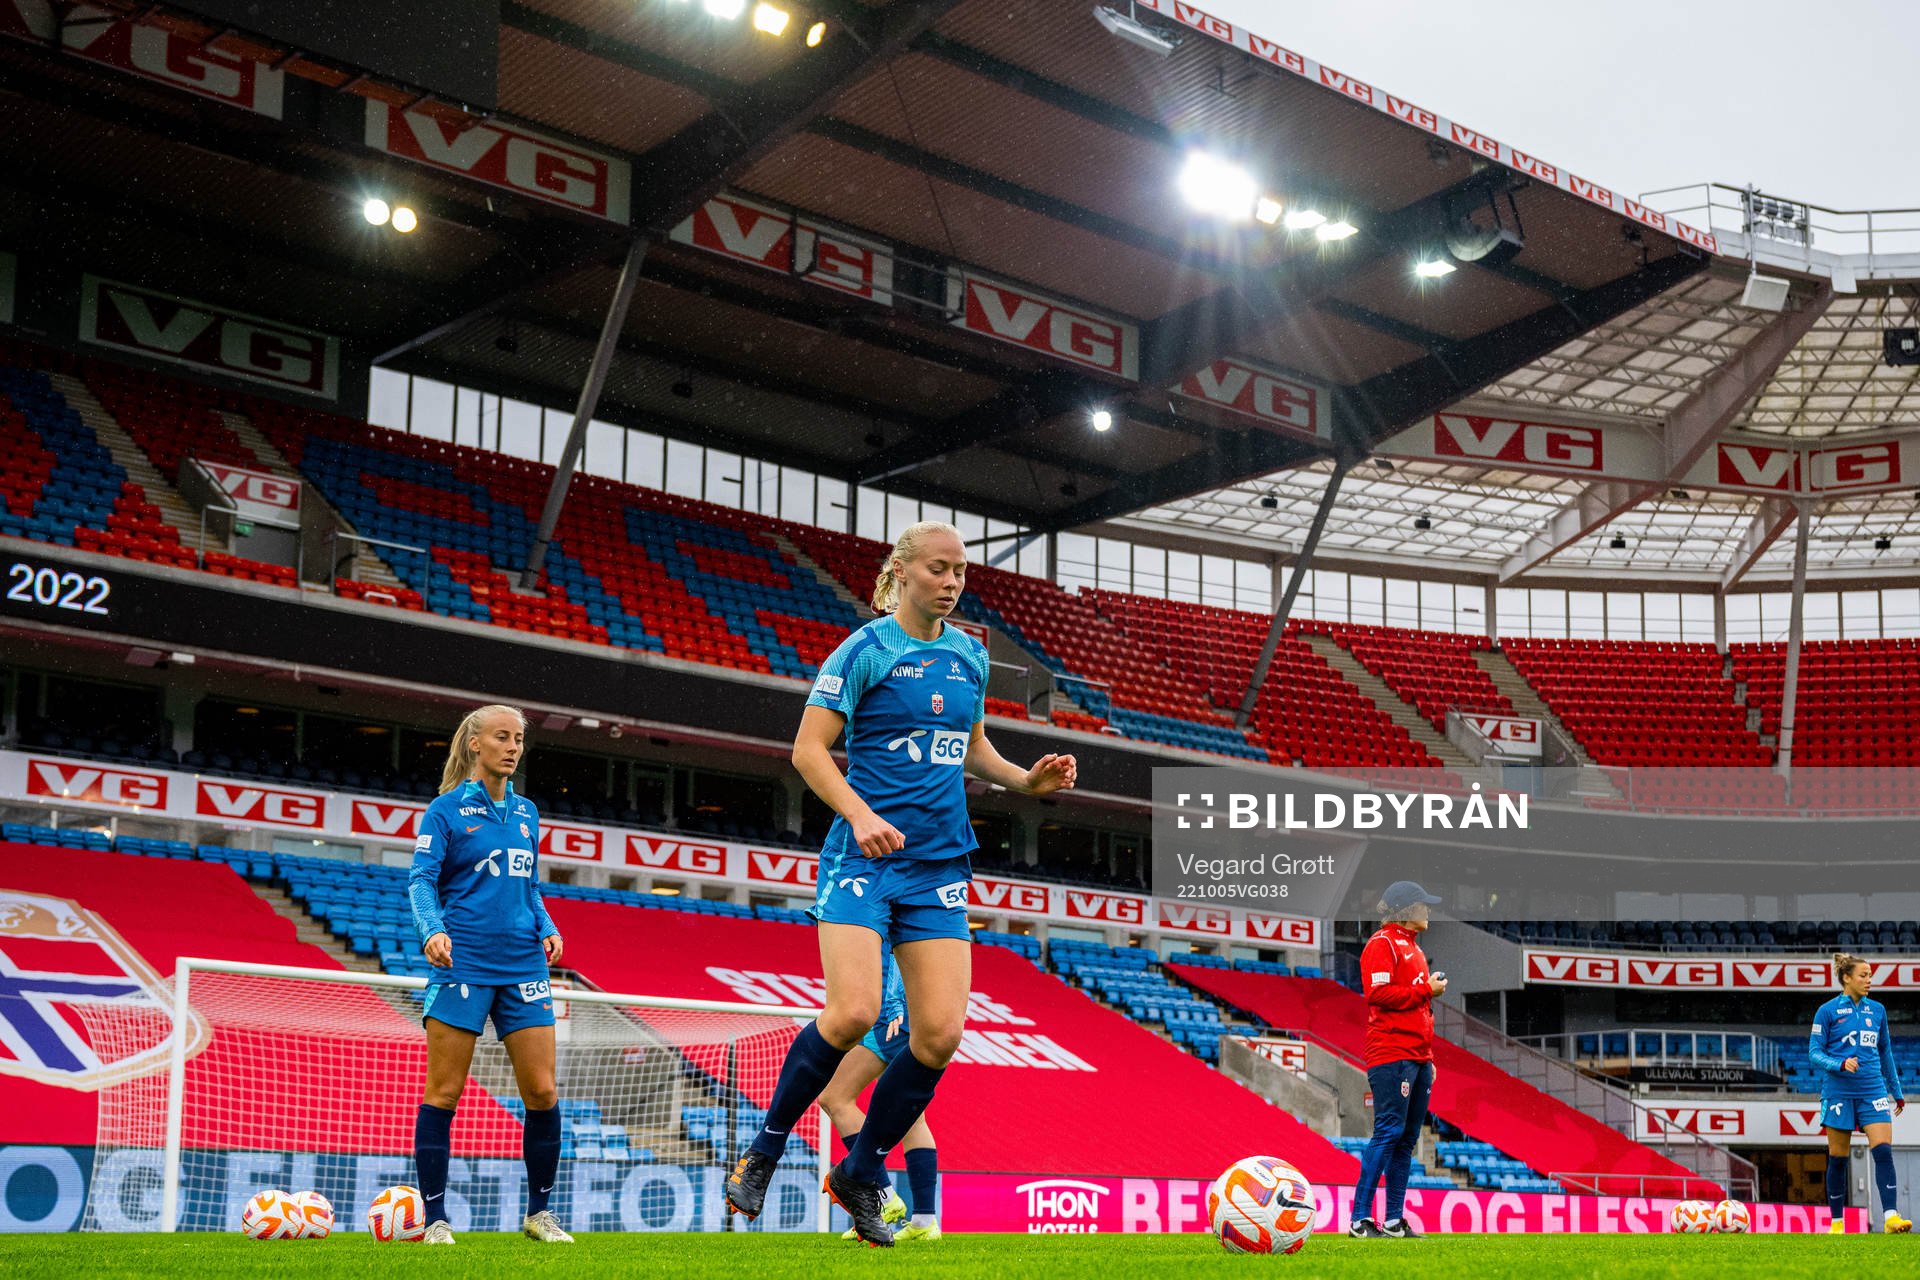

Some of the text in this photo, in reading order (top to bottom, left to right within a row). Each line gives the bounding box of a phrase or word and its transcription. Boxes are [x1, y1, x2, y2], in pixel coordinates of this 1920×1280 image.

[1177, 4, 1232, 42] VG
[1251, 35, 1304, 73] VG
[1320, 67, 1372, 103] VG
[1388, 96, 1437, 132] VG
[402, 107, 597, 208] VG
[1453, 123, 1499, 158] VG
[1513, 151, 1557, 183] VG
[1571, 177, 1612, 207] VG
[1625, 200, 1665, 229] VG
[708, 199, 866, 290] VG
[1677, 224, 1716, 251] VG
[107, 290, 313, 384] VG
[967, 279, 1115, 368] VG
[1196, 360, 1309, 428] VG
[1438, 416, 1595, 467] VG
[1720, 445, 1892, 490] VG
[206, 467, 292, 507] VG
[6, 563, 111, 616] 2022
[891, 665, 914, 678] KIWI
[934, 736, 964, 759] 5G
[1466, 718, 1533, 742] VG
[34, 762, 165, 810] VG
[202, 784, 323, 827] VG
[356, 802, 427, 838] V
[629, 837, 723, 874] VG
[970, 880, 1045, 913] VG
[1068, 892, 1140, 924] VG
[1161, 903, 1229, 933] VG
[1248, 914, 1311, 943] VG
[1530, 955, 1616, 982] VG
[1631, 961, 1720, 986] VG
[1735, 963, 1827, 986] VG
[525, 980, 549, 997] 5G
[1862, 1033, 1876, 1044] 5G
[1645, 1068, 1744, 1081] ULLEVAAL STADION
[1654, 1108, 1742, 1134] VG
[1016, 1180, 1110, 1218] THON
[1440, 1190, 1526, 1233] OG
